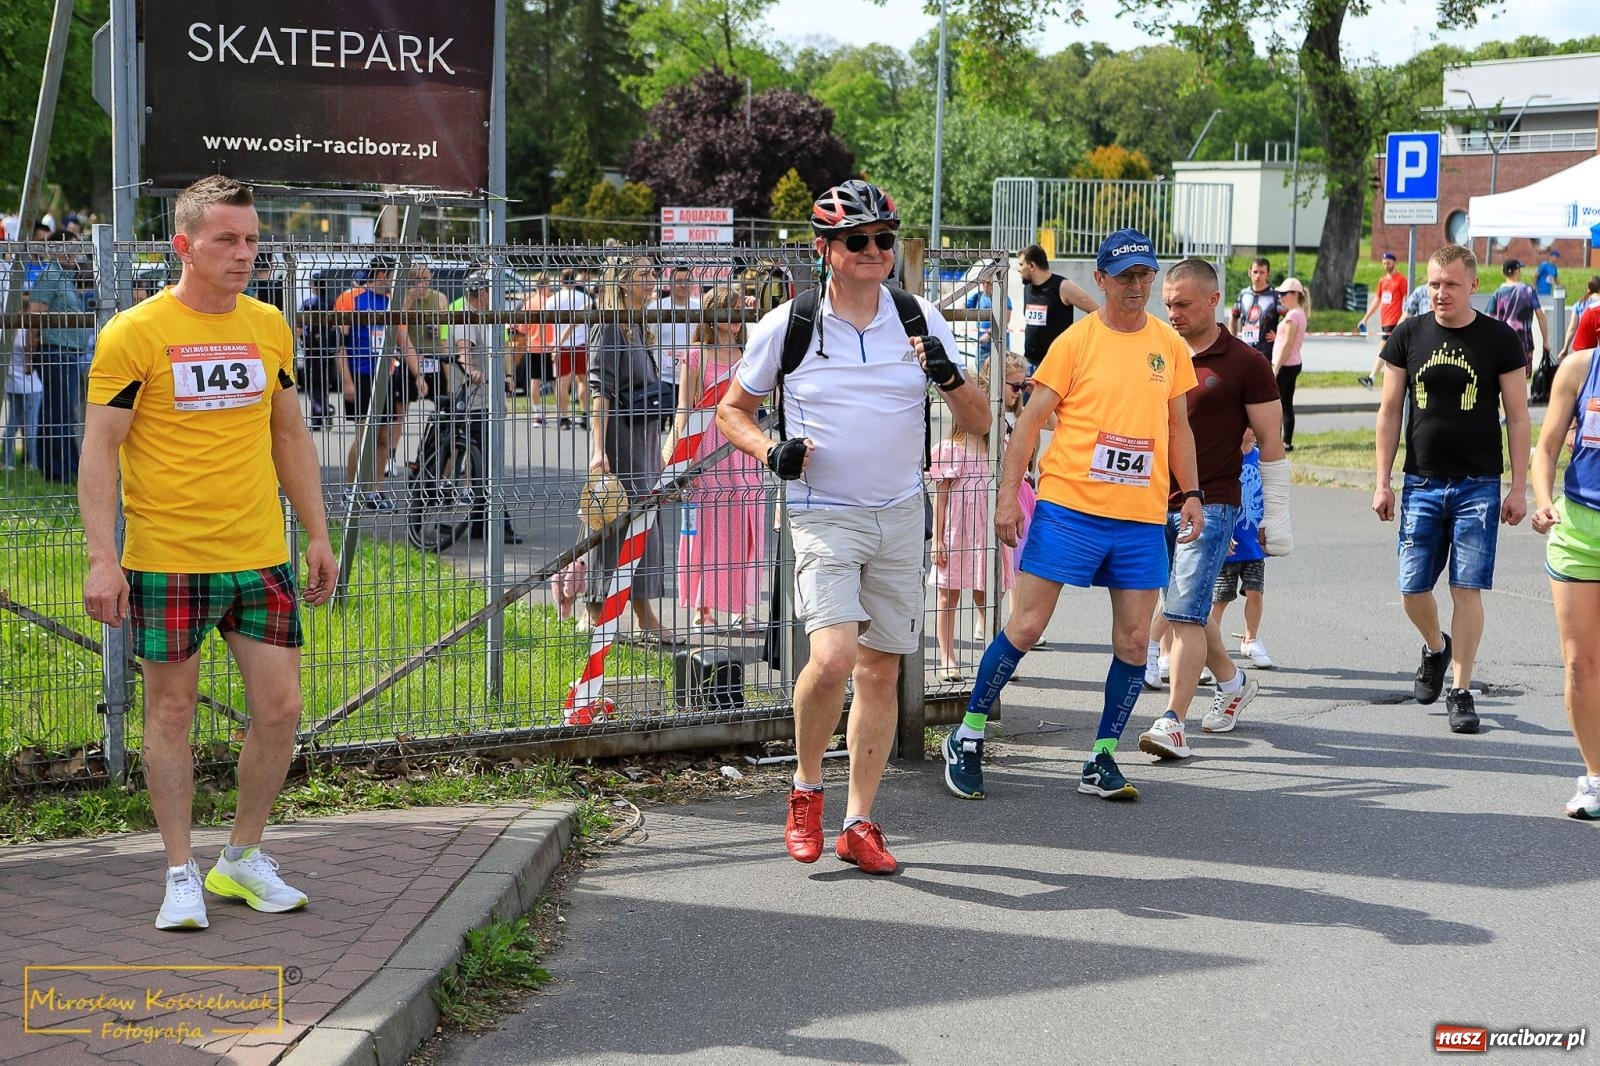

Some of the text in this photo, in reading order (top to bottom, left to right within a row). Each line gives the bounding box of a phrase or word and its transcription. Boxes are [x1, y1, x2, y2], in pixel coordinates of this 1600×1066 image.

[187, 22, 456, 75] SKATEPARK
[202, 133, 439, 160] www.osir-raciborz.pl
[1396, 140, 1428, 193] P
[678, 209, 729, 223] AQUAPARK
[688, 229, 719, 241] KORTY
[1111, 243, 1150, 257] adidas
[1028, 311, 1043, 320] 235
[190, 362, 250, 393] 143
[1106, 448, 1145, 473] 154
